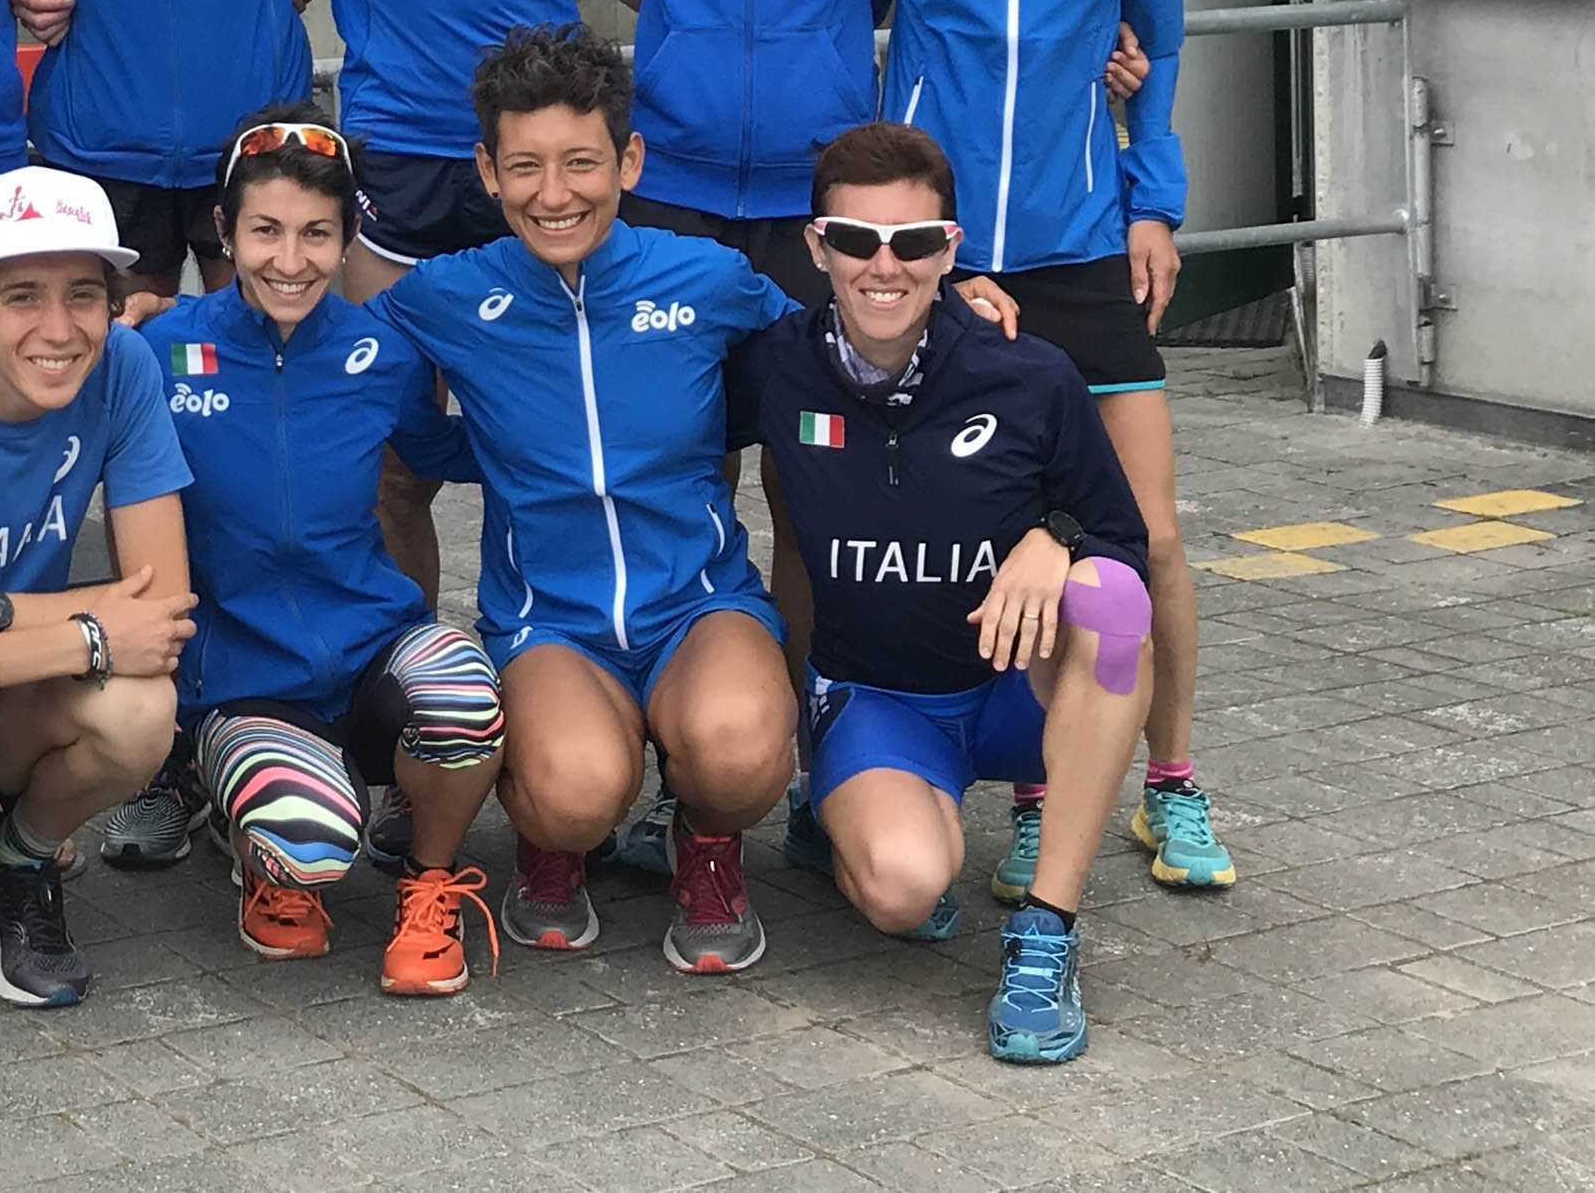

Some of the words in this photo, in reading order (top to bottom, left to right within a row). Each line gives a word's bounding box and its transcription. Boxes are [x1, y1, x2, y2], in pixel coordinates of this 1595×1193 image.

[631, 300, 696, 333] eolo
[170, 383, 230, 417] eolo
[830, 538, 998, 582] ITALIA
